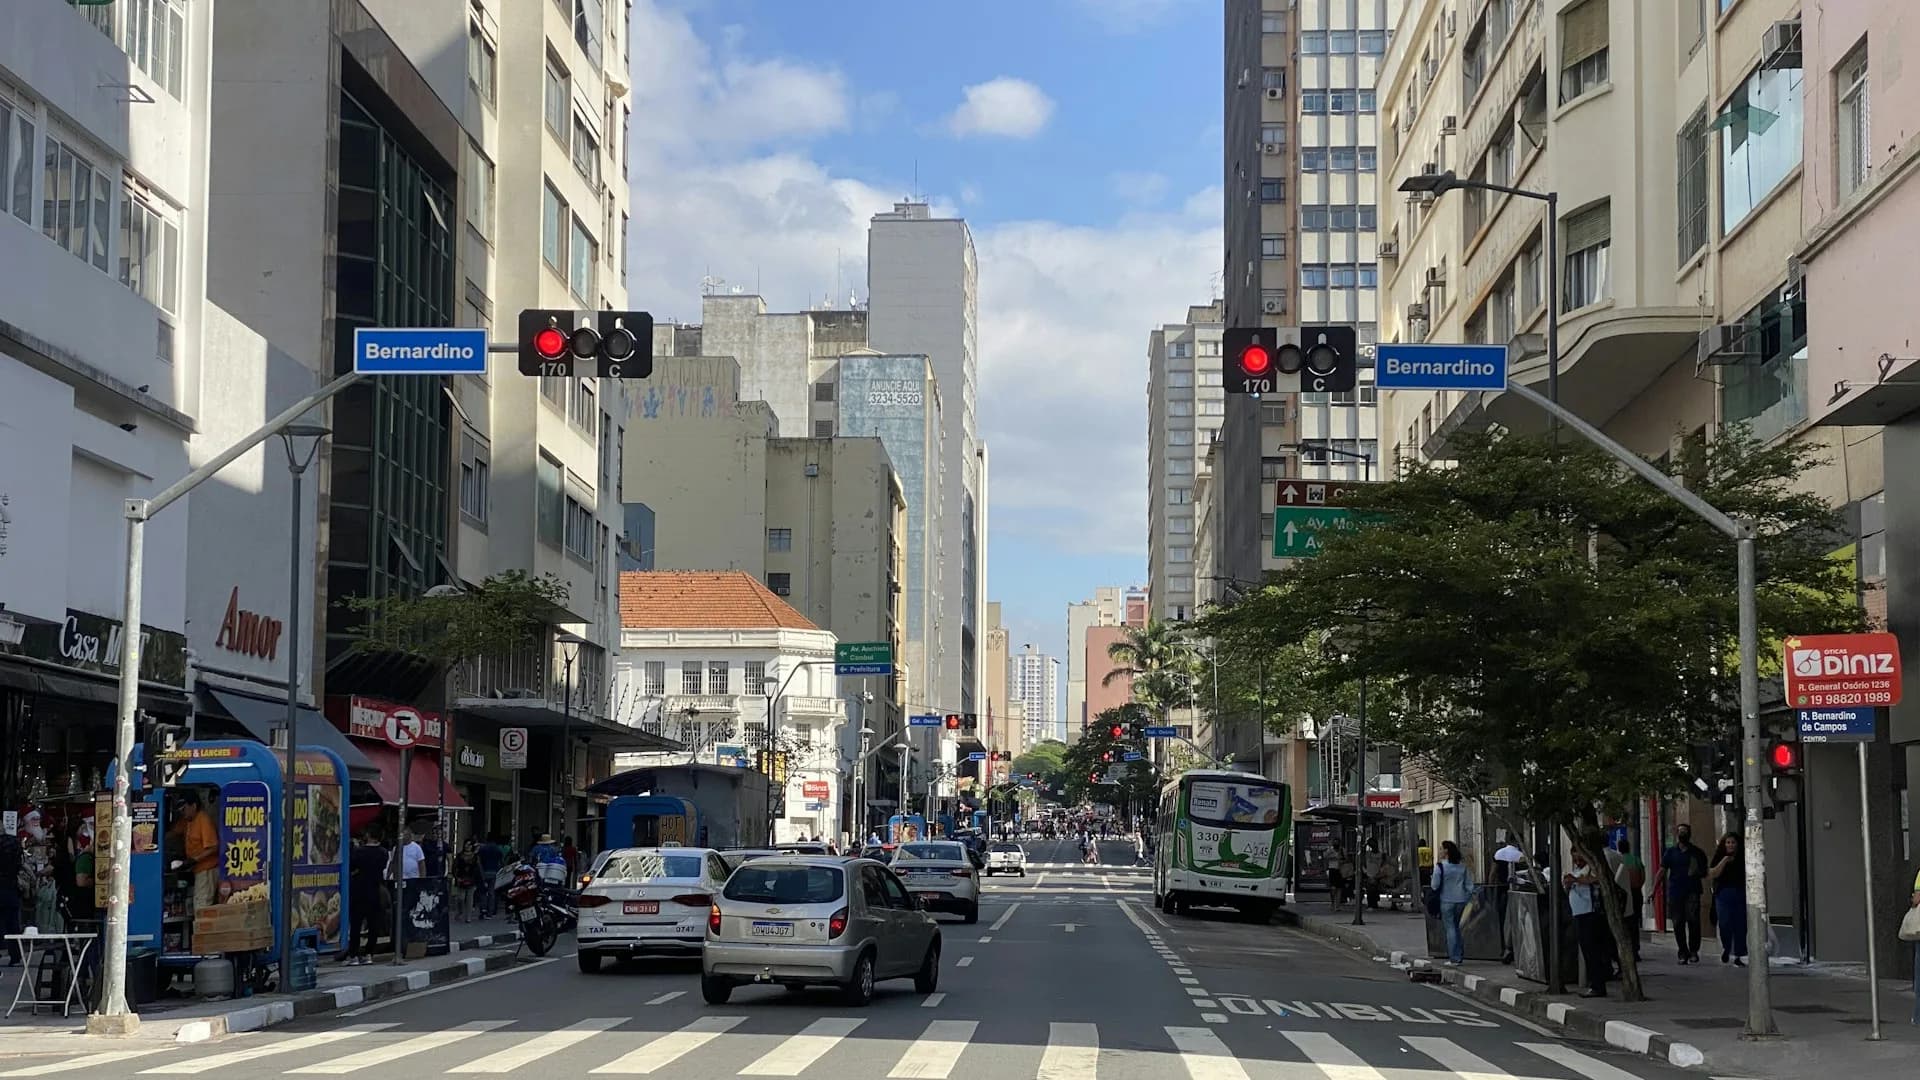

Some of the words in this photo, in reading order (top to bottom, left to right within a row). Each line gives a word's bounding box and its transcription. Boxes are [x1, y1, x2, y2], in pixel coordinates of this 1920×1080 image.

[366, 343, 474, 360] Bernardino
[539, 362, 567, 377] 170
[609, 363, 621, 378] C
[1386, 358, 1495, 377] Bernardino
[871, 380, 901, 391] ANUNCIE
[1243, 379, 1271, 392] 170
[1313, 379, 1325, 392] C
[871, 393, 920, 404] 3234-5520
[215, 585, 282, 661] Amor
[59, 615, 99, 663] Casa
[1798, 684, 1806, 692] R.
[1808, 682, 1841, 691] General
[1842, 681, 1870, 690] Osório
[1871, 681, 1891, 689] 1236
[1810, 695, 1823, 705] 19
[1825, 694, 1862, 705] 98820
[1864, 692, 1891, 703] 1989
[1801, 711, 1810, 721] R.
[1811, 711, 1857, 720] Bernardino
[1801, 723, 1812, 732] de
[1813, 722, 1848, 732] Campos
[509, 734, 518, 747] E
[1370, 800, 1400, 808] BANCA
[225, 806, 244, 826] HOT
[245, 806, 265, 827] DOG
[230, 846, 254, 871] 9,00
